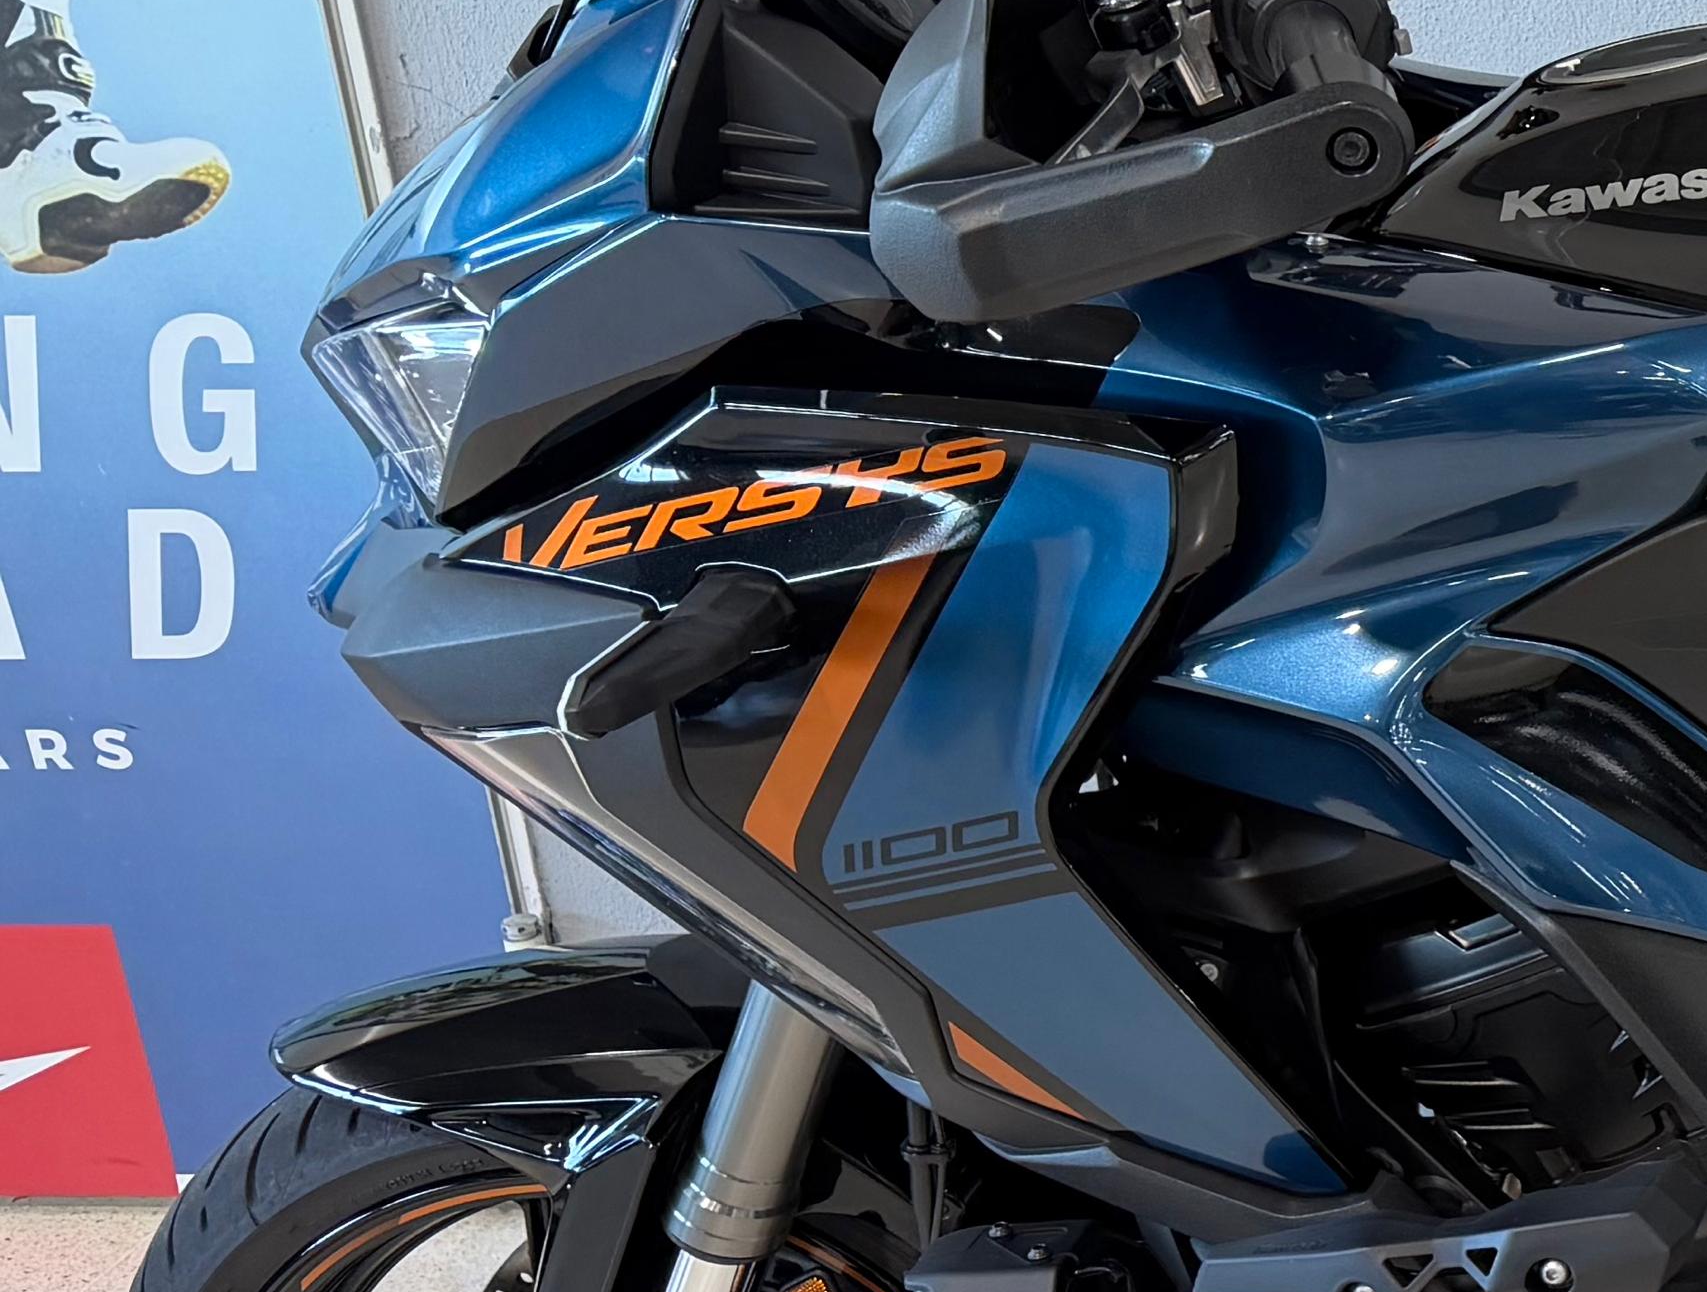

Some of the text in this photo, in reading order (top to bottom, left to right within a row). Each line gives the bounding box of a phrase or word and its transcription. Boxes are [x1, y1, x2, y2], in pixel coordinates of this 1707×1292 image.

[502, 436, 1006, 571] VERSYS
[0, 508, 236, 660] D
[0, 728, 135, 771] RS
[842, 810, 1020, 875] 1100
